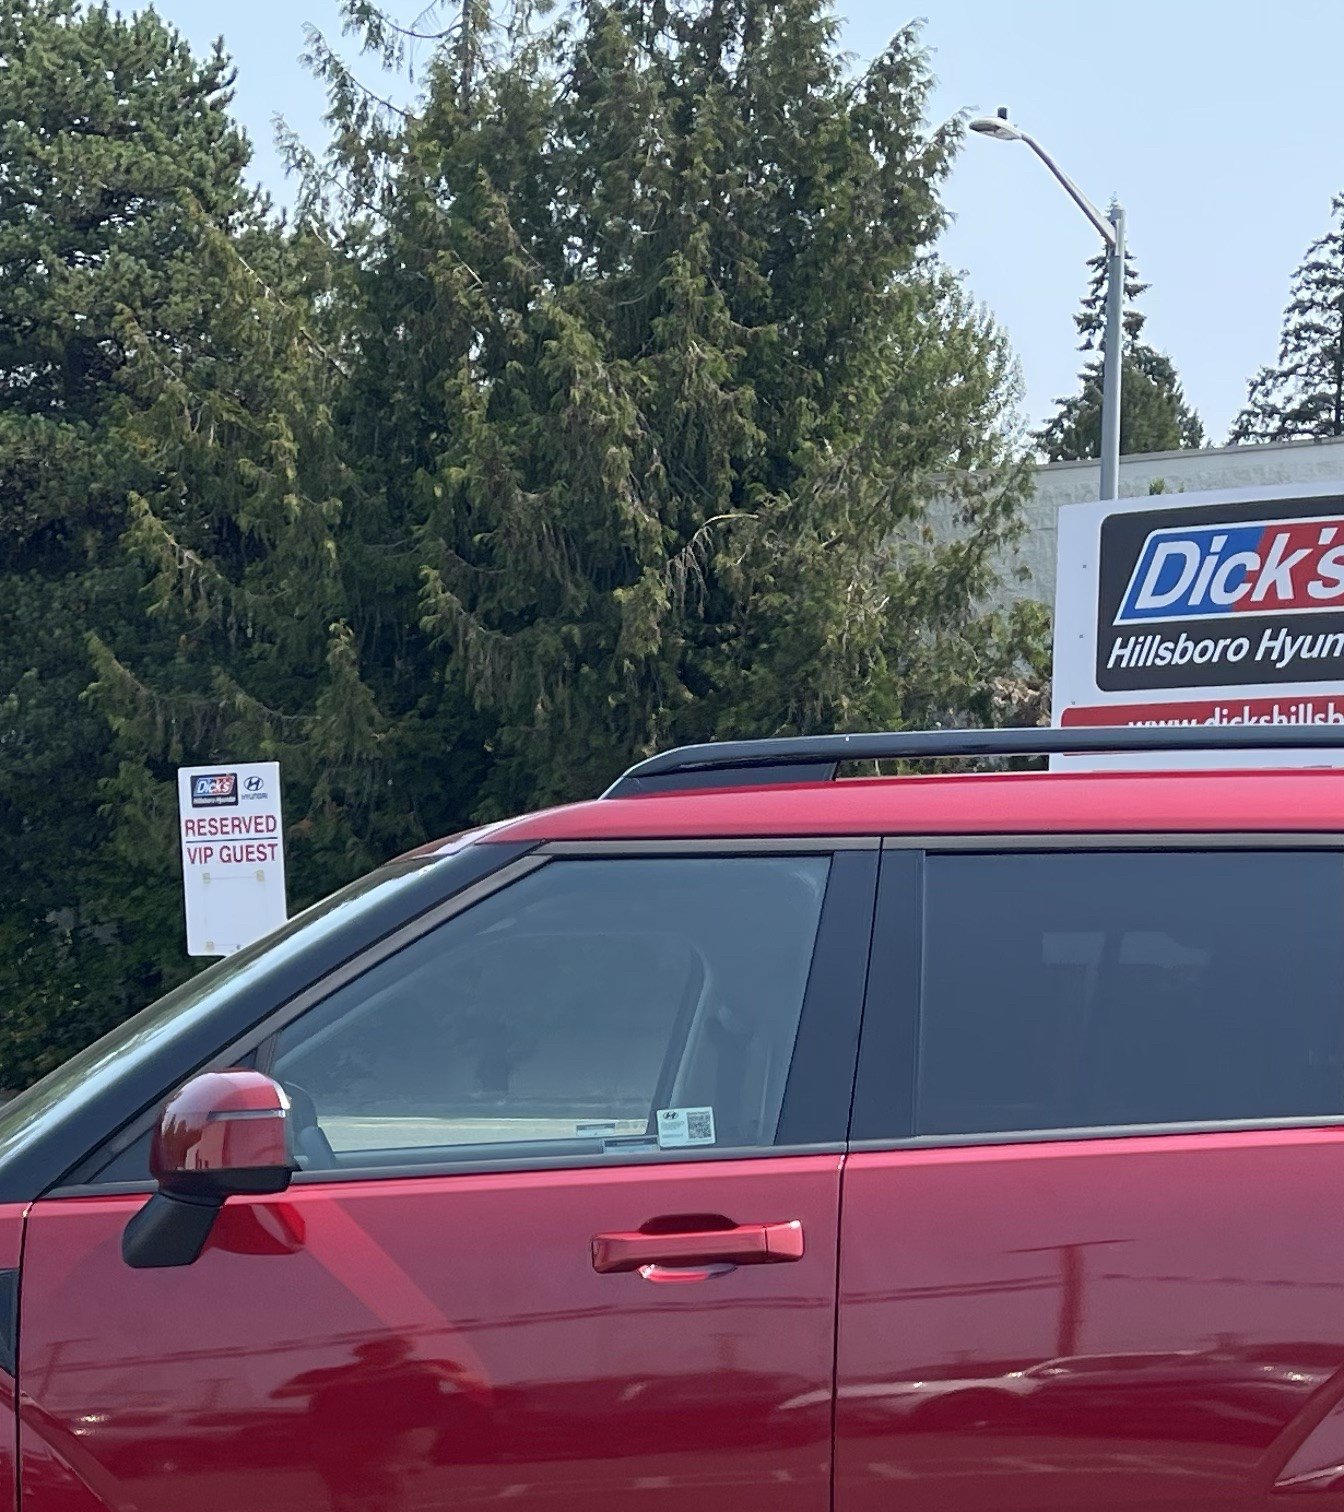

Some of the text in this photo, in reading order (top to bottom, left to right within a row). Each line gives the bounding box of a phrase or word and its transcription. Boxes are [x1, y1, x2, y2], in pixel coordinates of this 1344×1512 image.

[1106, 633, 1250, 669] Hillsboro
[184, 814, 277, 837] RESERVED
[187, 843, 278, 865] VIP GUEST
